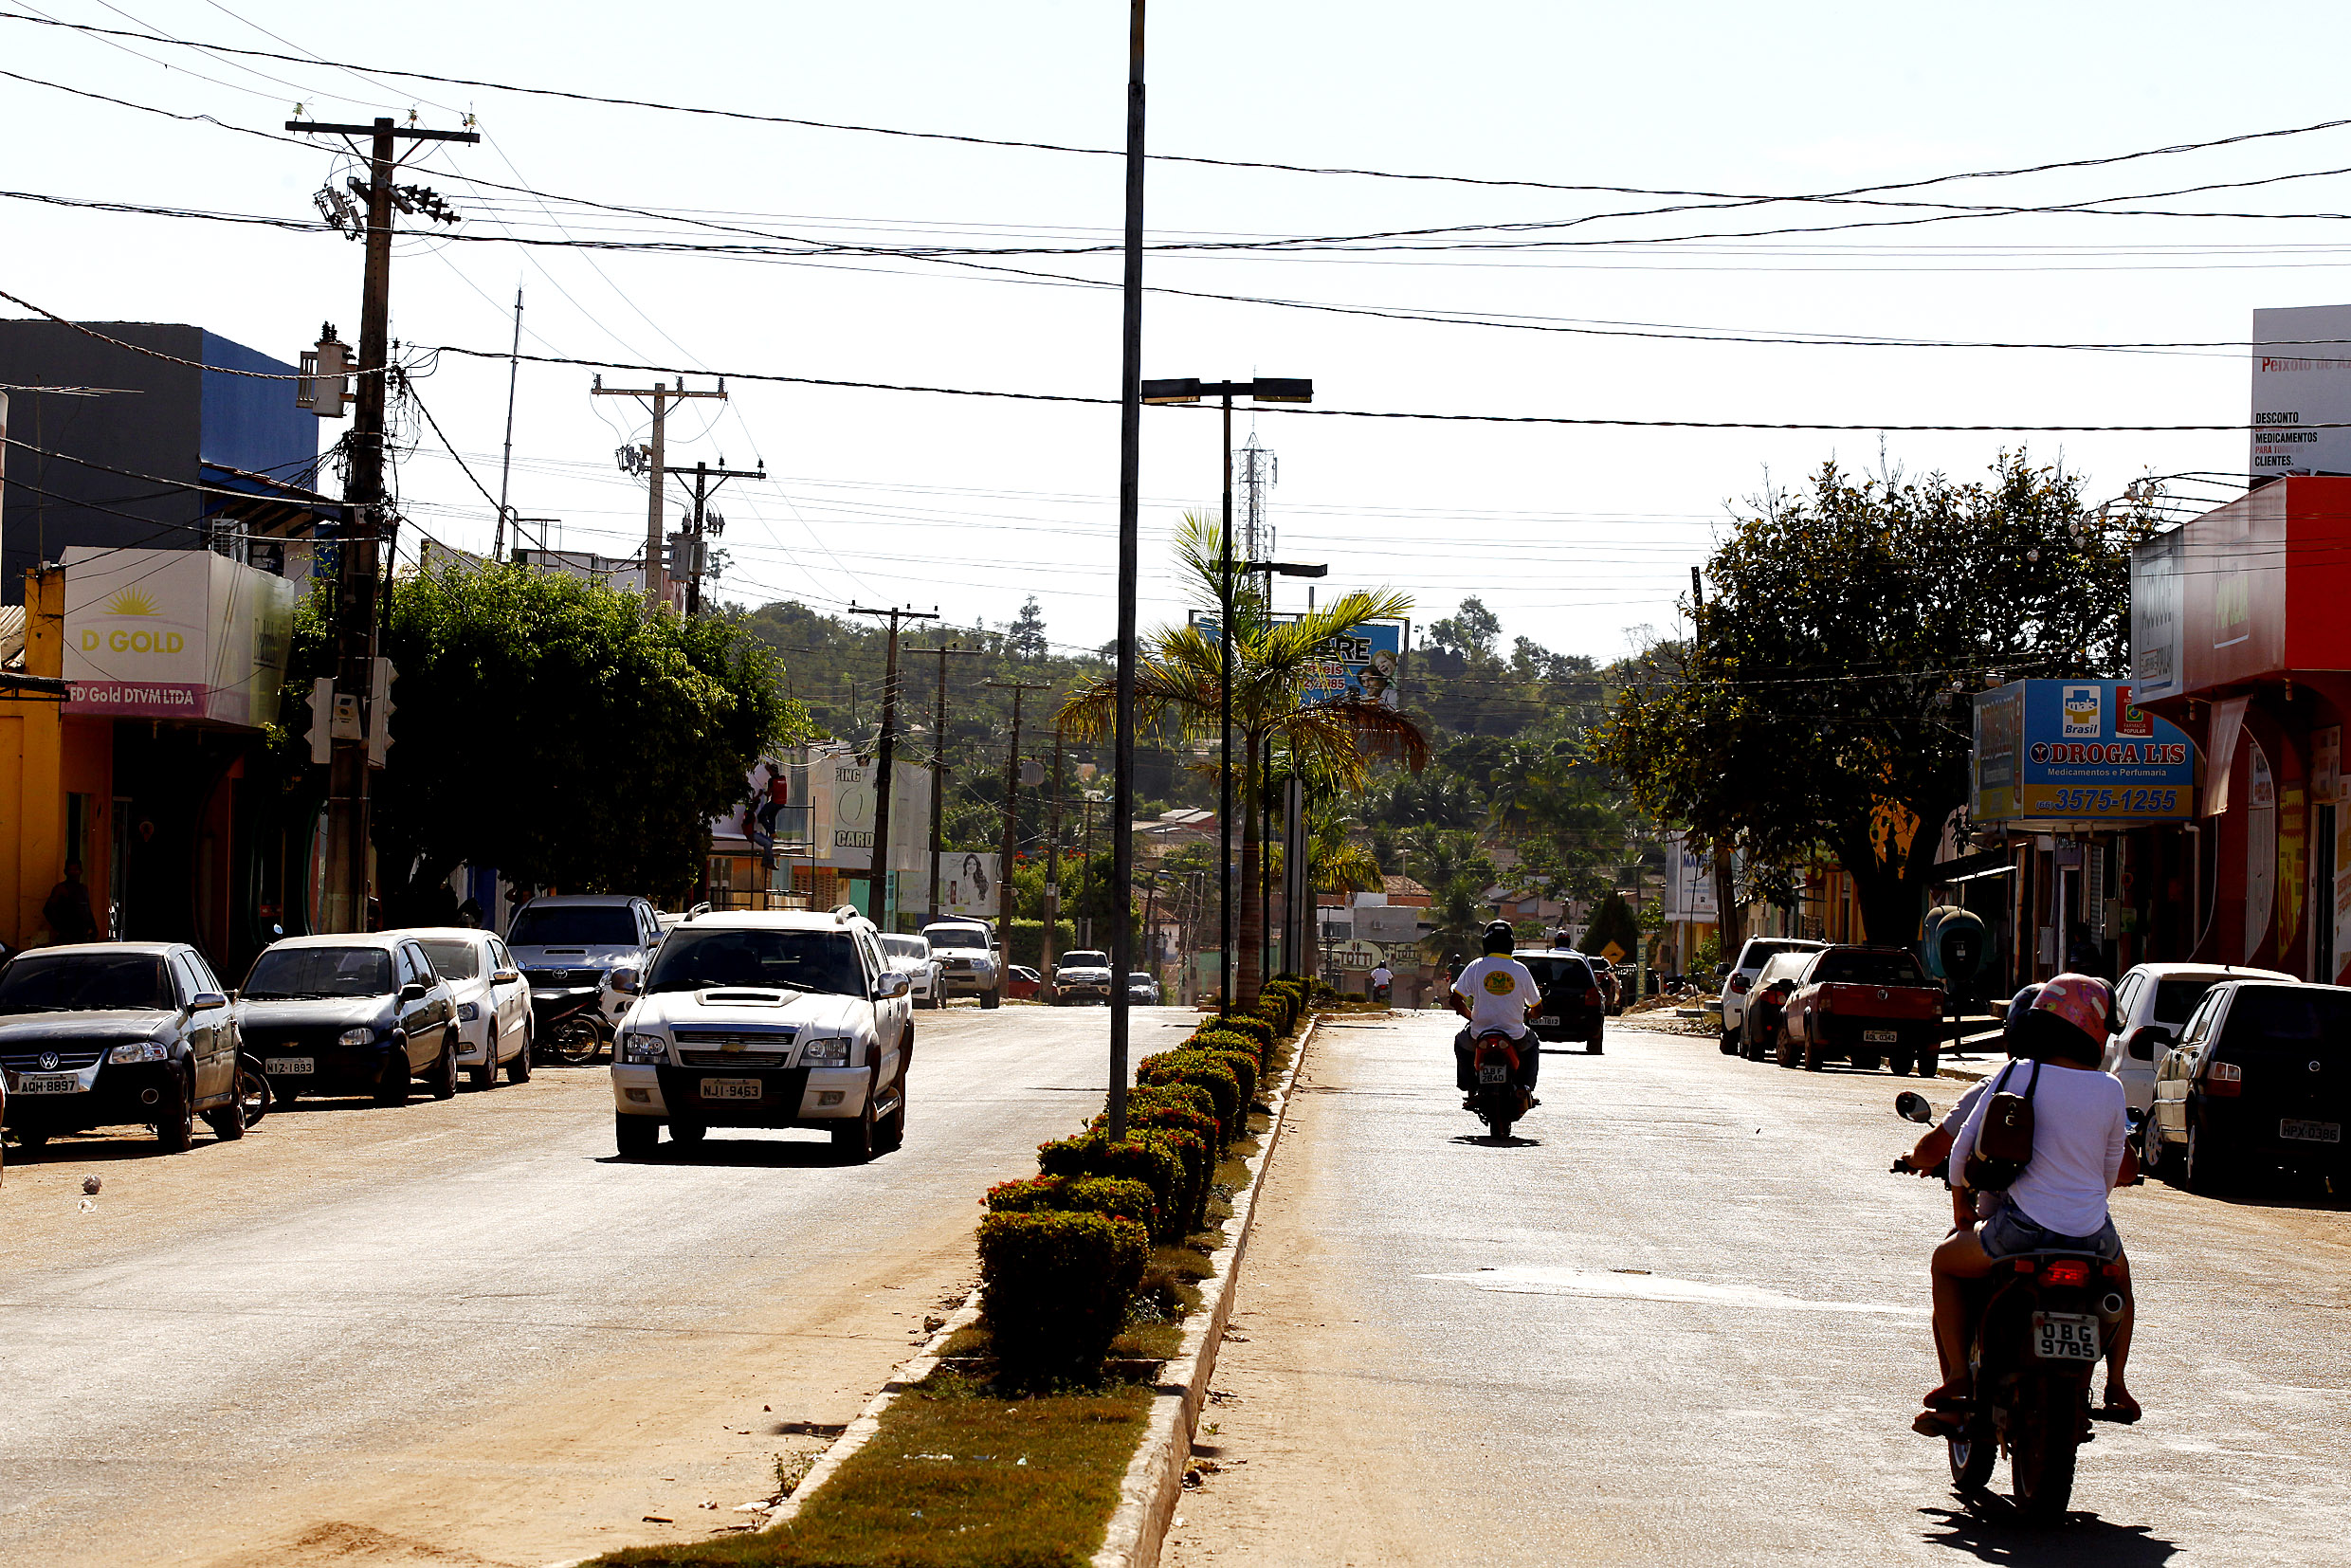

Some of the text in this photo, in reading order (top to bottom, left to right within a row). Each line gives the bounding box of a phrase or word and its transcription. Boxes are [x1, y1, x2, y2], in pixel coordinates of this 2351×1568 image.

[2262, 356, 2311, 372] Peixoto
[2255, 411, 2299, 424] DESCONTO
[2255, 432, 2318, 444] MEDICAMENTOS
[2255, 445, 2272, 454] PARA
[2254, 455, 2294, 466] CLIENTES.
[108, 629, 185, 654] GOLD
[89, 686, 121, 702] Gold
[124, 687, 161, 704] DTVM
[163, 689, 194, 705] LTDA
[2068, 699, 2096, 710] mais
[2065, 724, 2097, 734] Brasil
[2050, 742, 2185, 765] DROGA LIS
[2048, 768, 2110, 776] Medicamentos
[2120, 768, 2167, 776] Perfumaria
[2035, 788, 2178, 812] (66) 3575-1255
[1340, 951, 1373, 966] TOTTI
[2041, 1339, 2095, 1358] 9785
